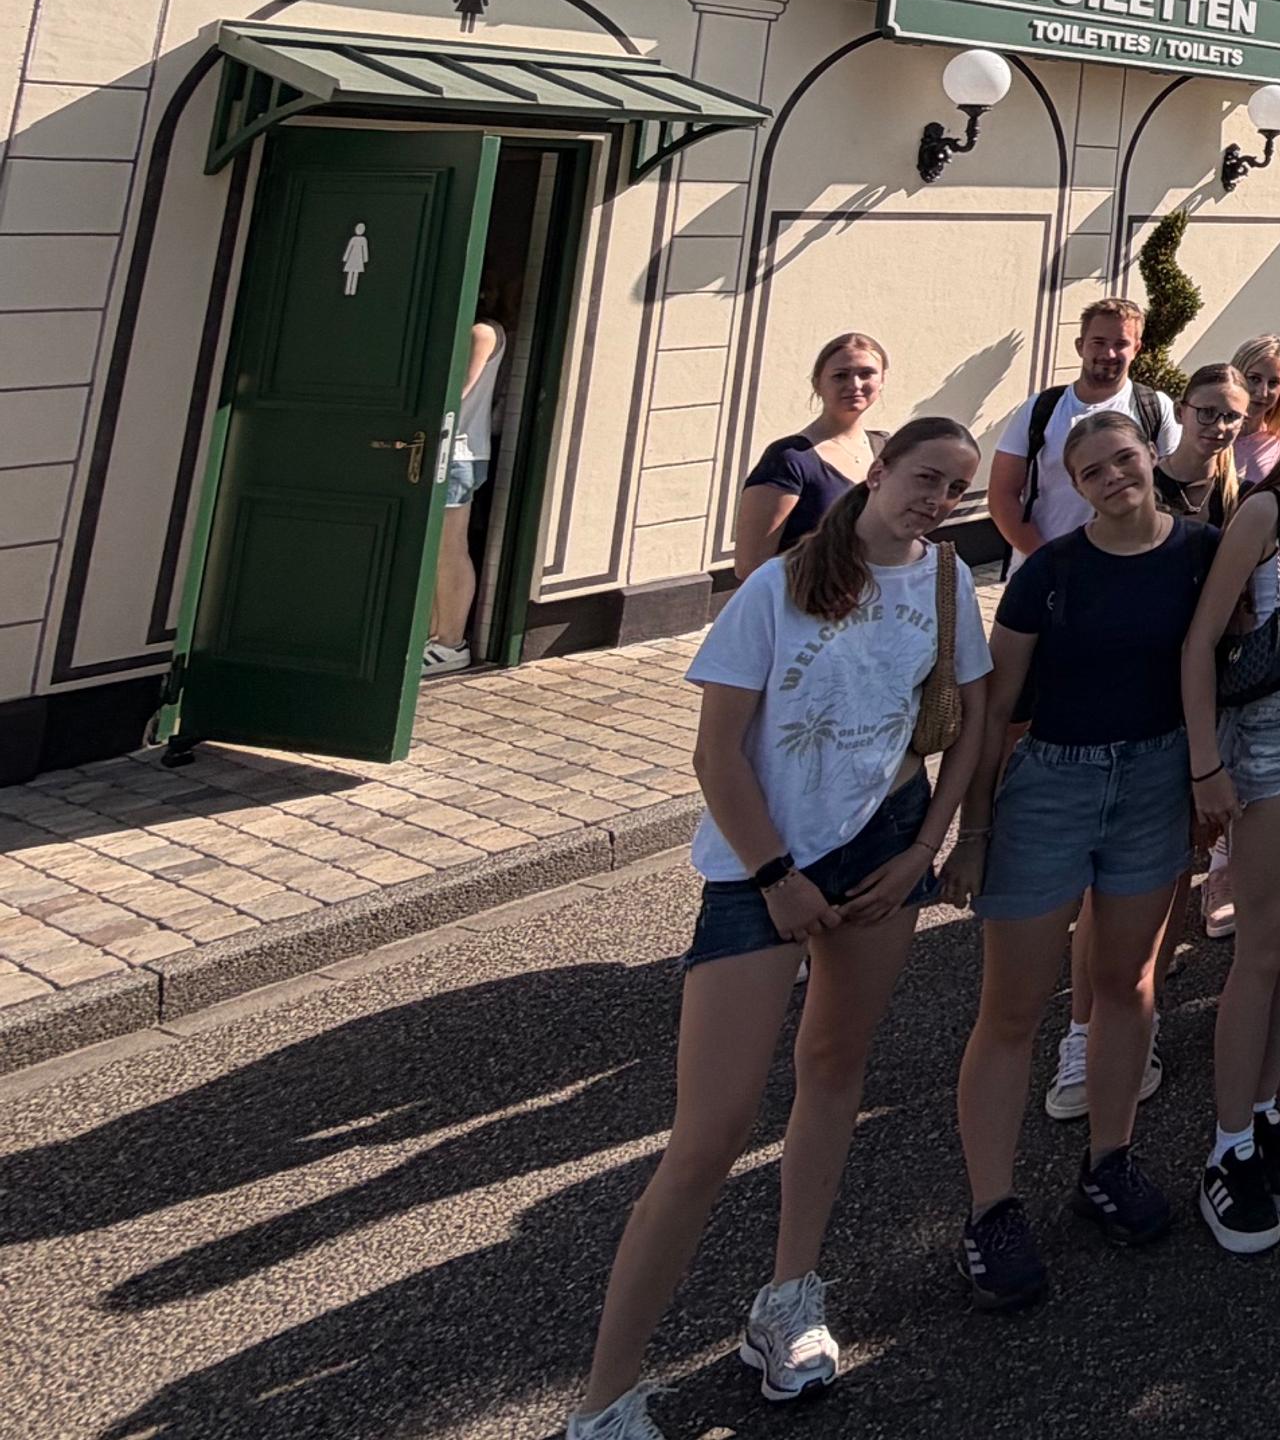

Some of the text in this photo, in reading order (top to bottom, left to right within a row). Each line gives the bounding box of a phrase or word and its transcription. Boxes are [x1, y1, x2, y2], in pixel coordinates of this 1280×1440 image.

[1032, 19, 1151, 55] TOILETTES
[1165, 39, 1244, 66] TOILETS
[895, 604, 934, 633] THE
[838, 728, 855, 738] on
[836, 737, 874, 751] beach
